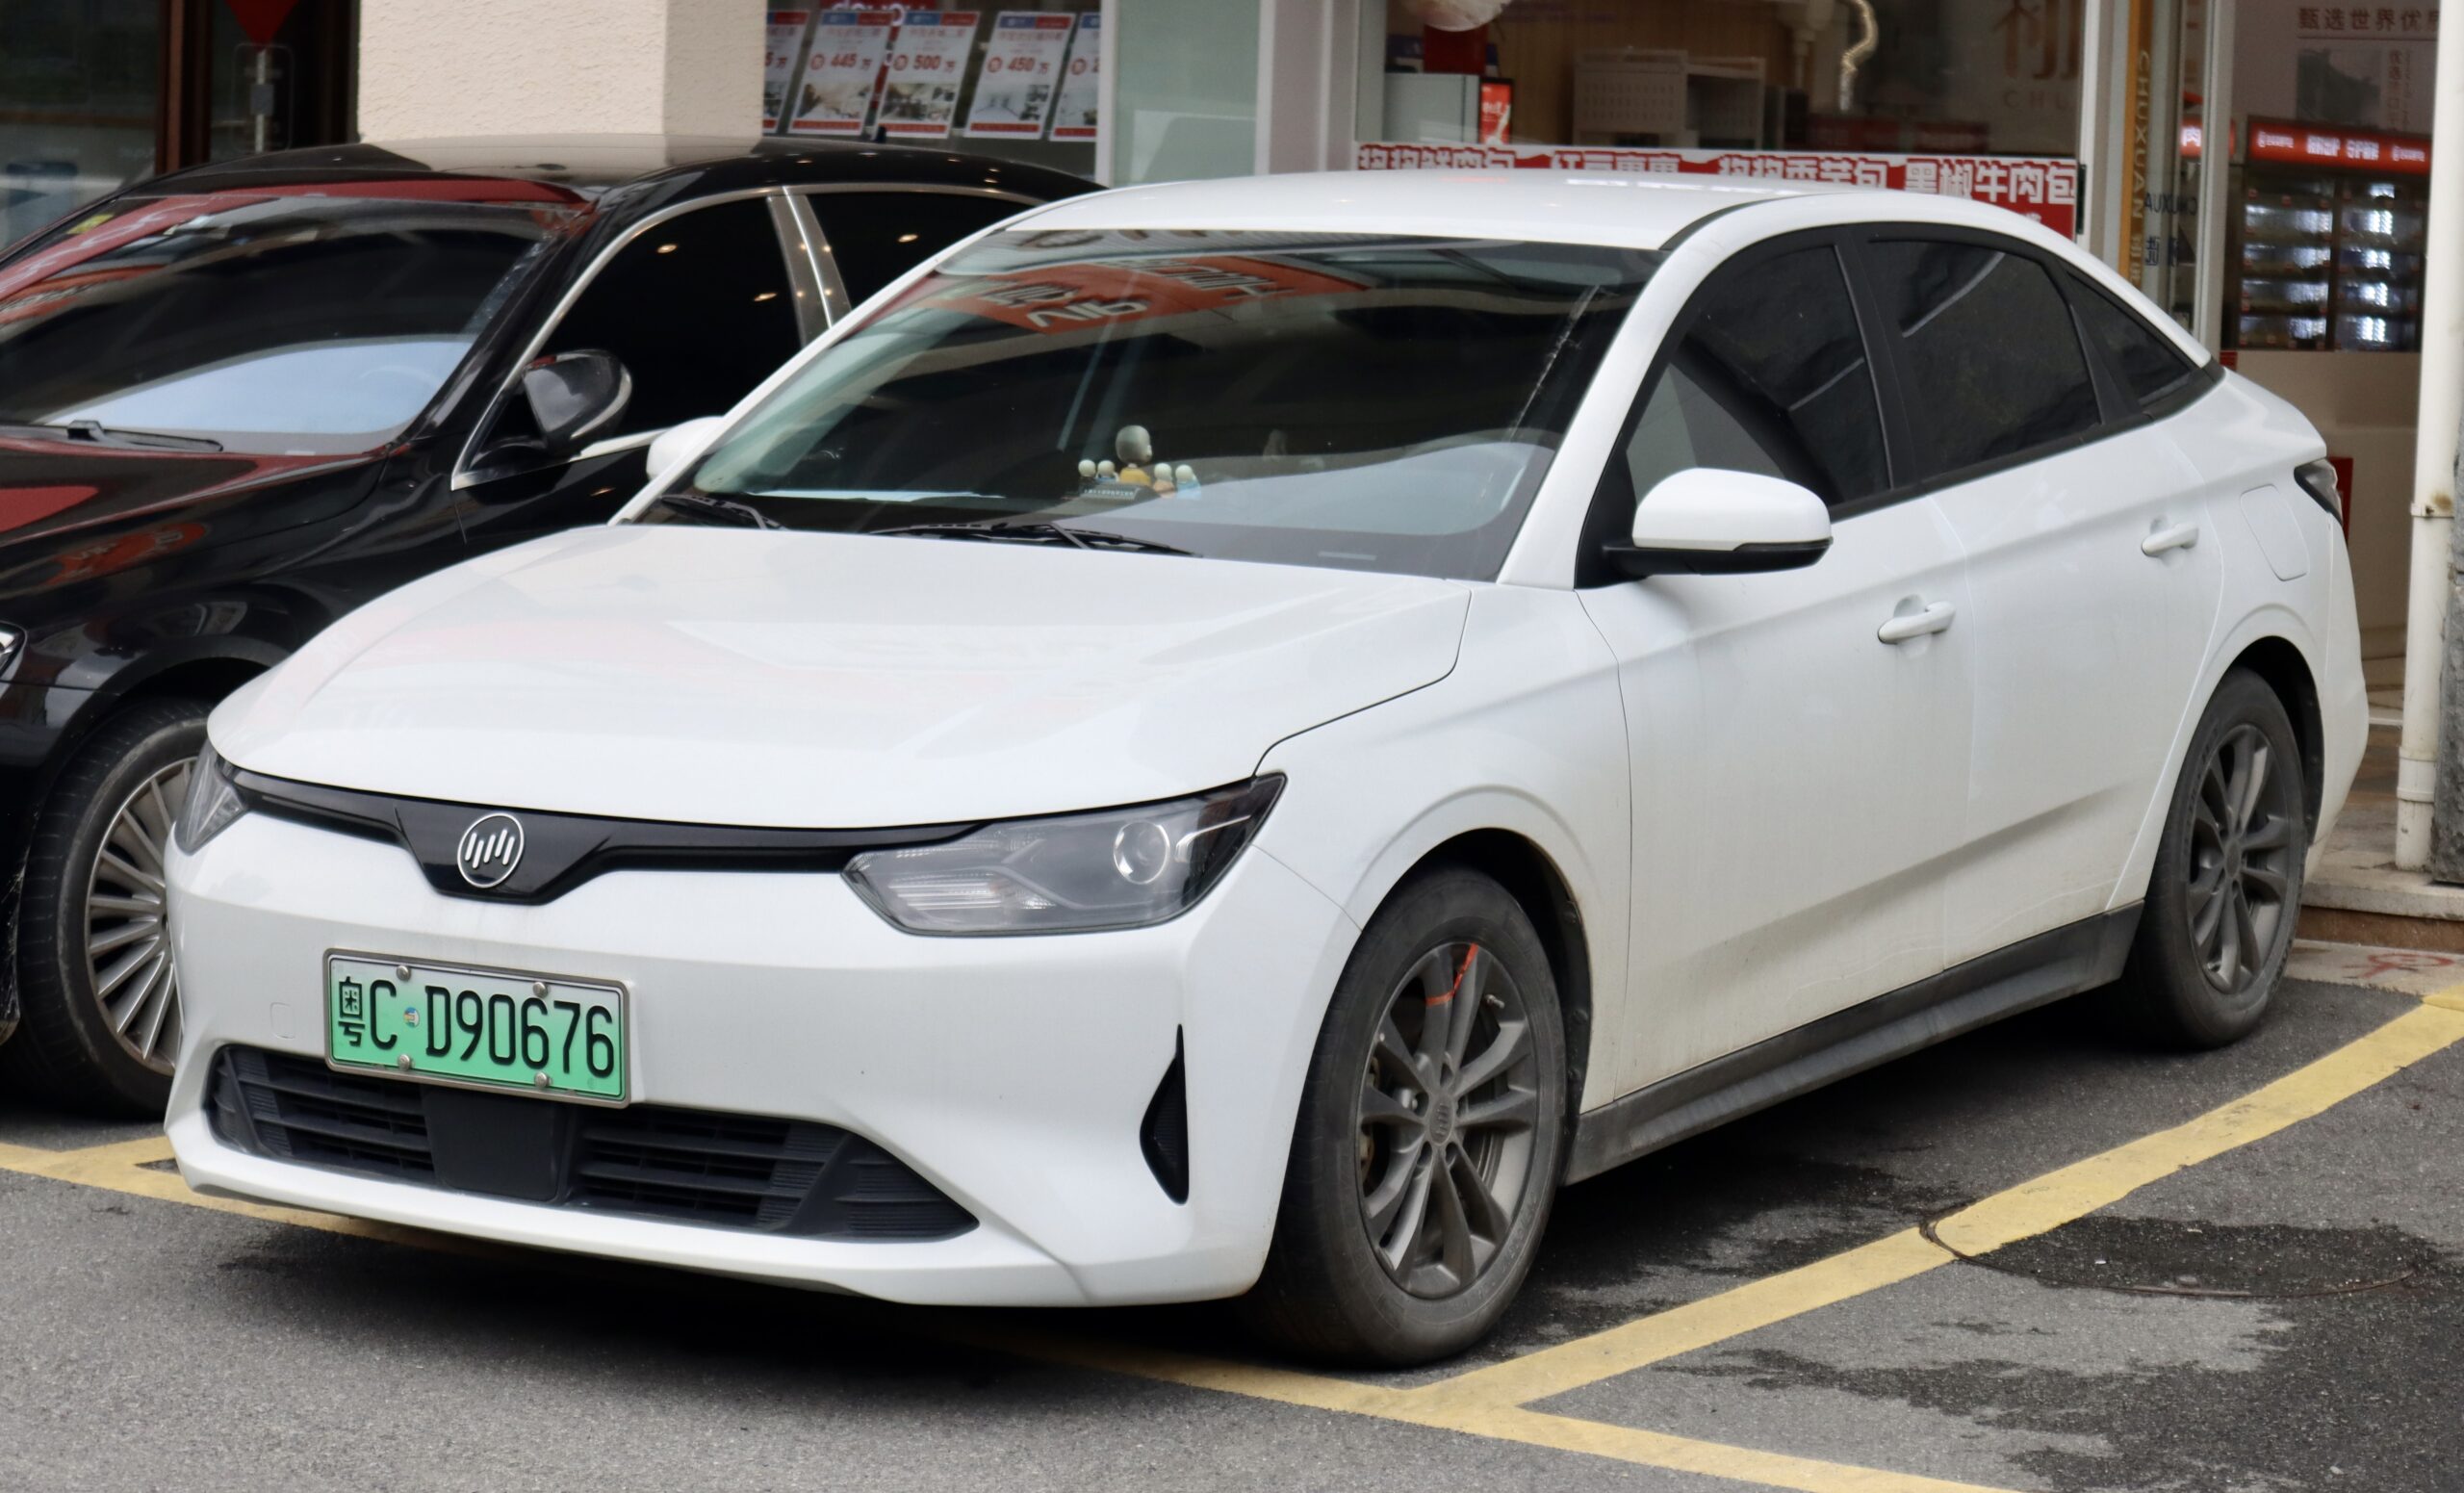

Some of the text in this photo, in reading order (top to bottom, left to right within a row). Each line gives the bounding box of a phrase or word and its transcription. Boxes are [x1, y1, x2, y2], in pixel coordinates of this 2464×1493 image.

[1905, 160, 2076, 205] 黑椒牛肉包
[338, 975, 615, 1079] 粤C D90676
